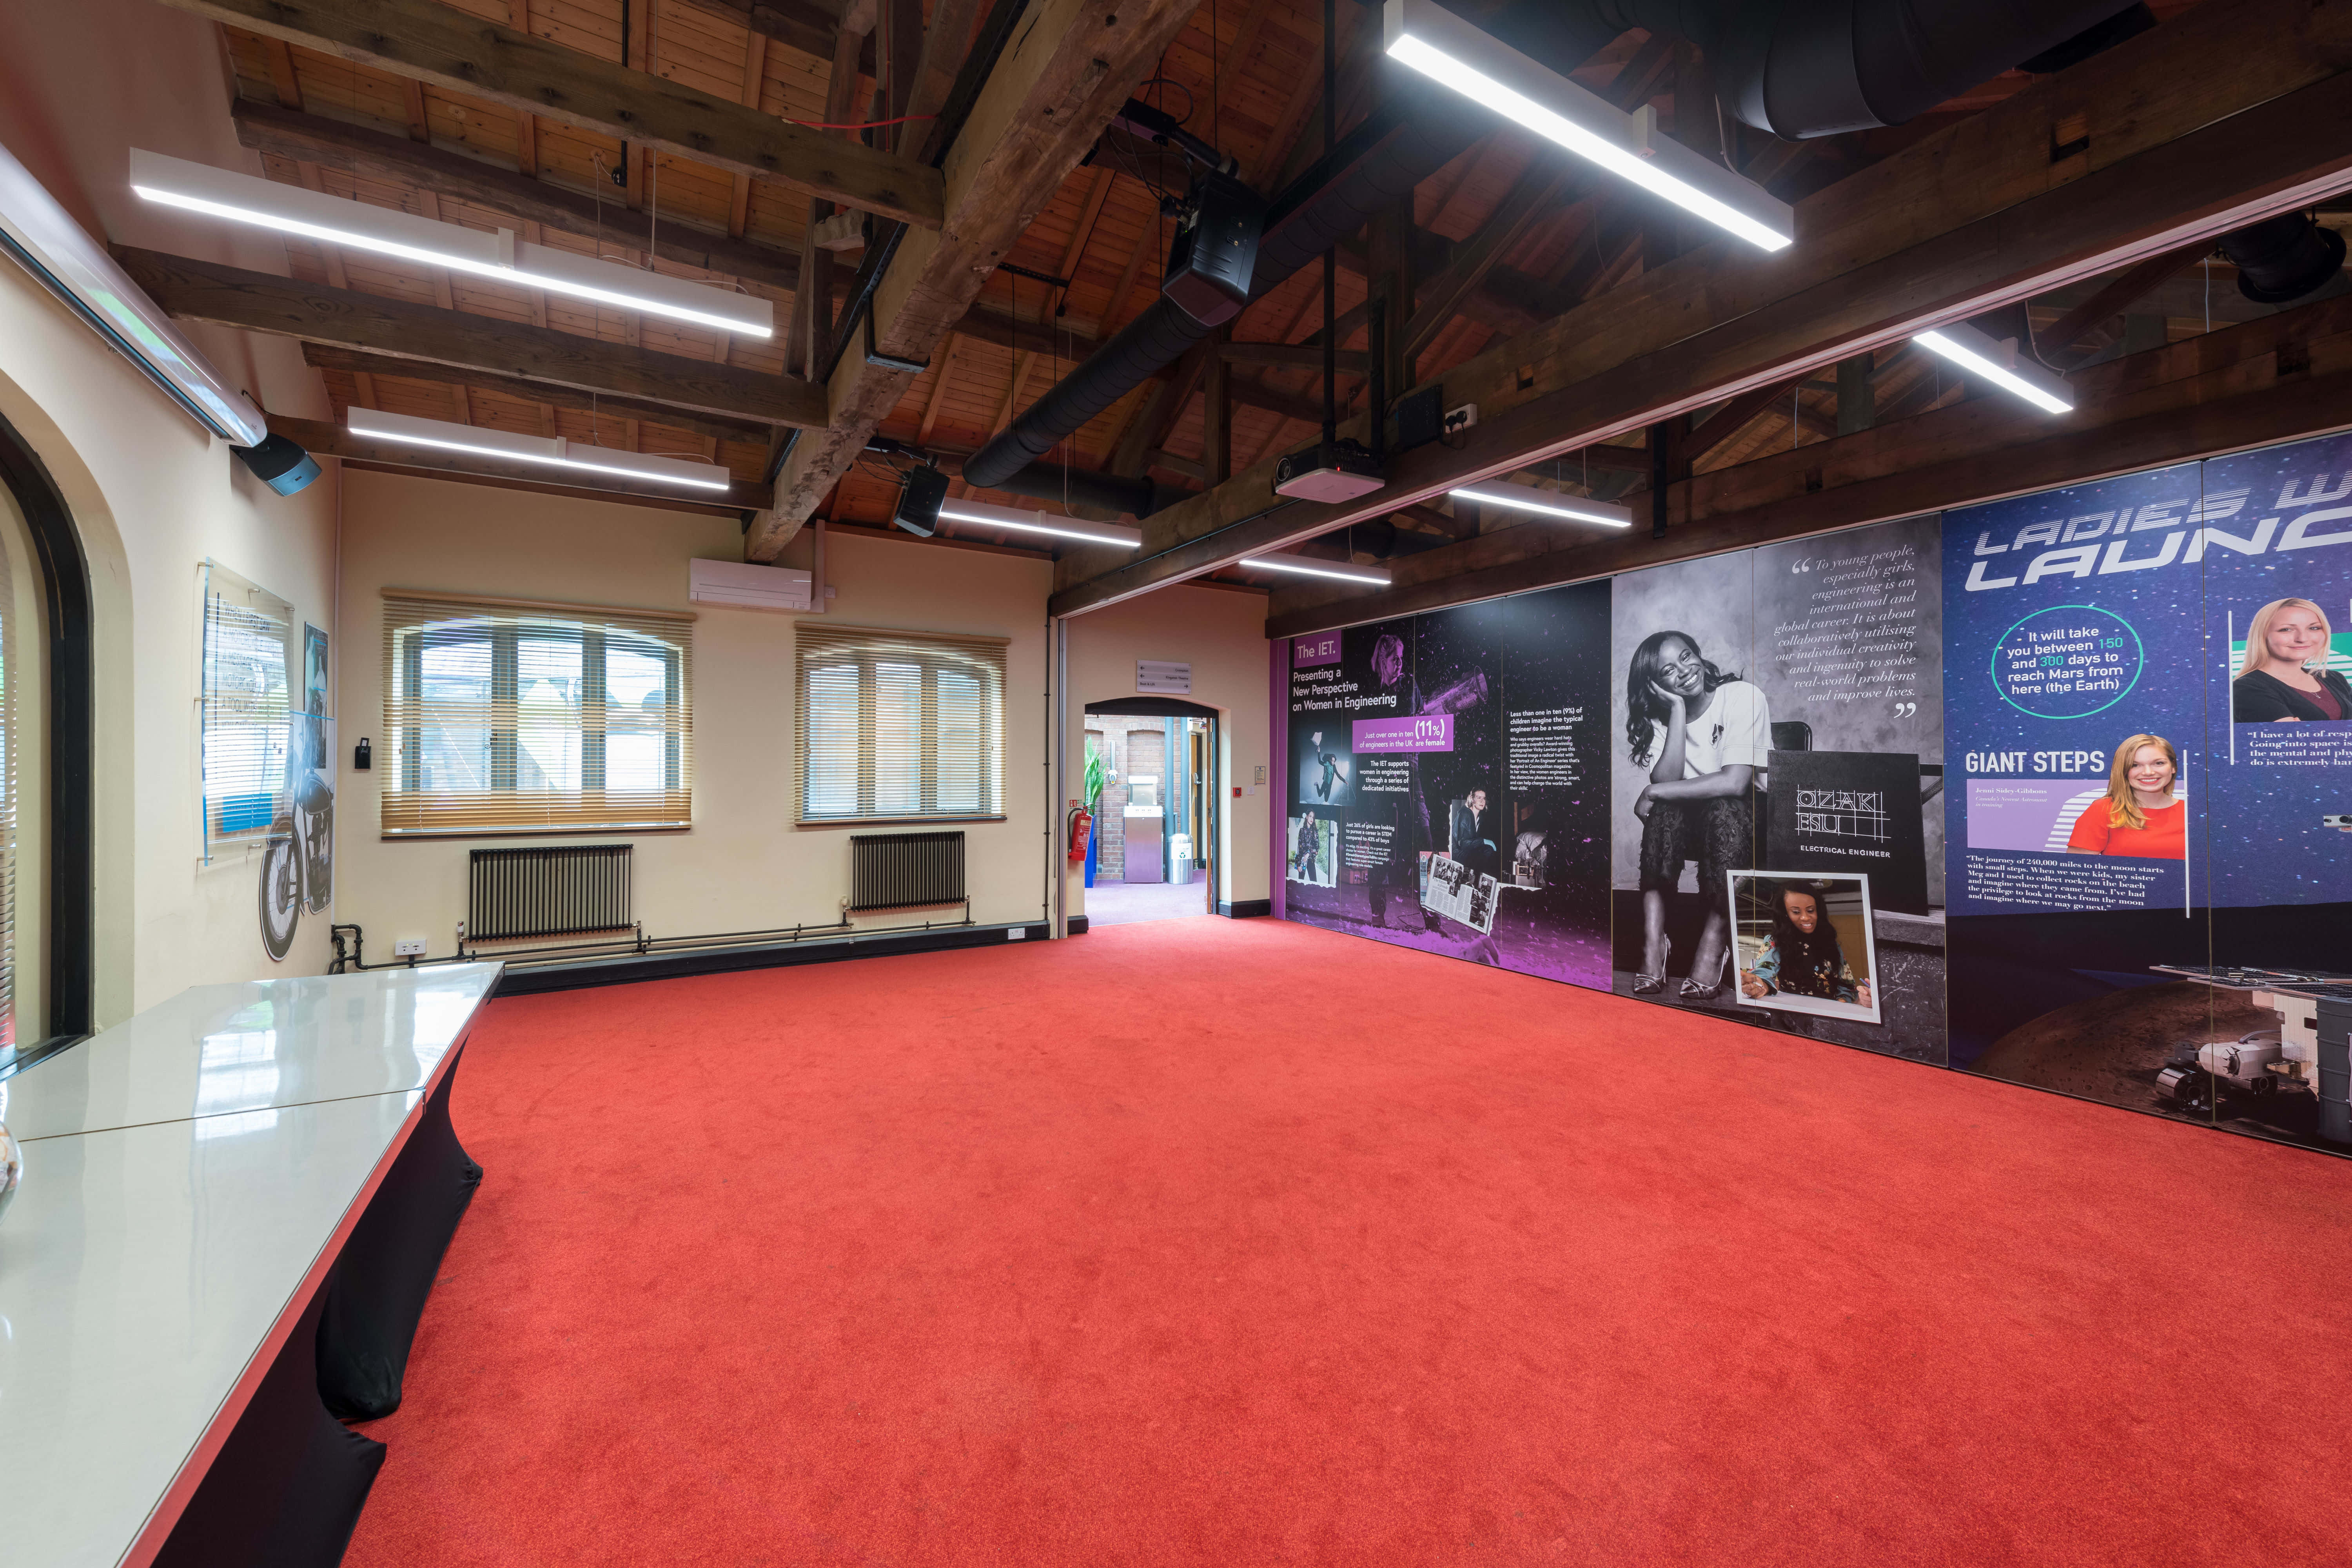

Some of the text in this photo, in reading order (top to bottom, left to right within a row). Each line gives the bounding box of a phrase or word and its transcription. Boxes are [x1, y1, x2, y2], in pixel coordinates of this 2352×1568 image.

[1974, 487, 2252, 556] LADIES
[1965, 506, 2352, 591] LAUNC
[1815, 544, 1914, 571] To young people,
[1823, 560, 1914, 585] especially girls,
[1812, 579, 1915, 601] engineering is an
[1809, 590, 1916, 614] international and
[260, 619, 270, 631] SAW
[2029, 627, 2099, 642] It will take
[1297, 641, 1335, 659] The IET.
[2007, 637, 2123, 659] you between 150
[2012, 652, 2118, 669] and 300 days to
[1294, 668, 1333, 682] Presenting
[2008, 666, 2123, 682] reach Mars from
[1293, 681, 1358, 697] New Perspective
[2012, 678, 2119, 694] here (the Earth)
[1304, 700, 1332, 710] Women
[1335, 697, 1342, 708] in
[1345, 693, 1396, 710] Engineering
[1563, 715, 1583, 723] typical
[1415, 719, 1445, 739] (11%)
[2250, 740, 2282, 749] Going
[1966, 750, 2105, 773] GIANT STEPS
[2278, 759, 2328, 767] extremely
[1800, 845, 1890, 858] ELECTRICAL ENGINEER
[1985, 856, 2014, 865] journey
